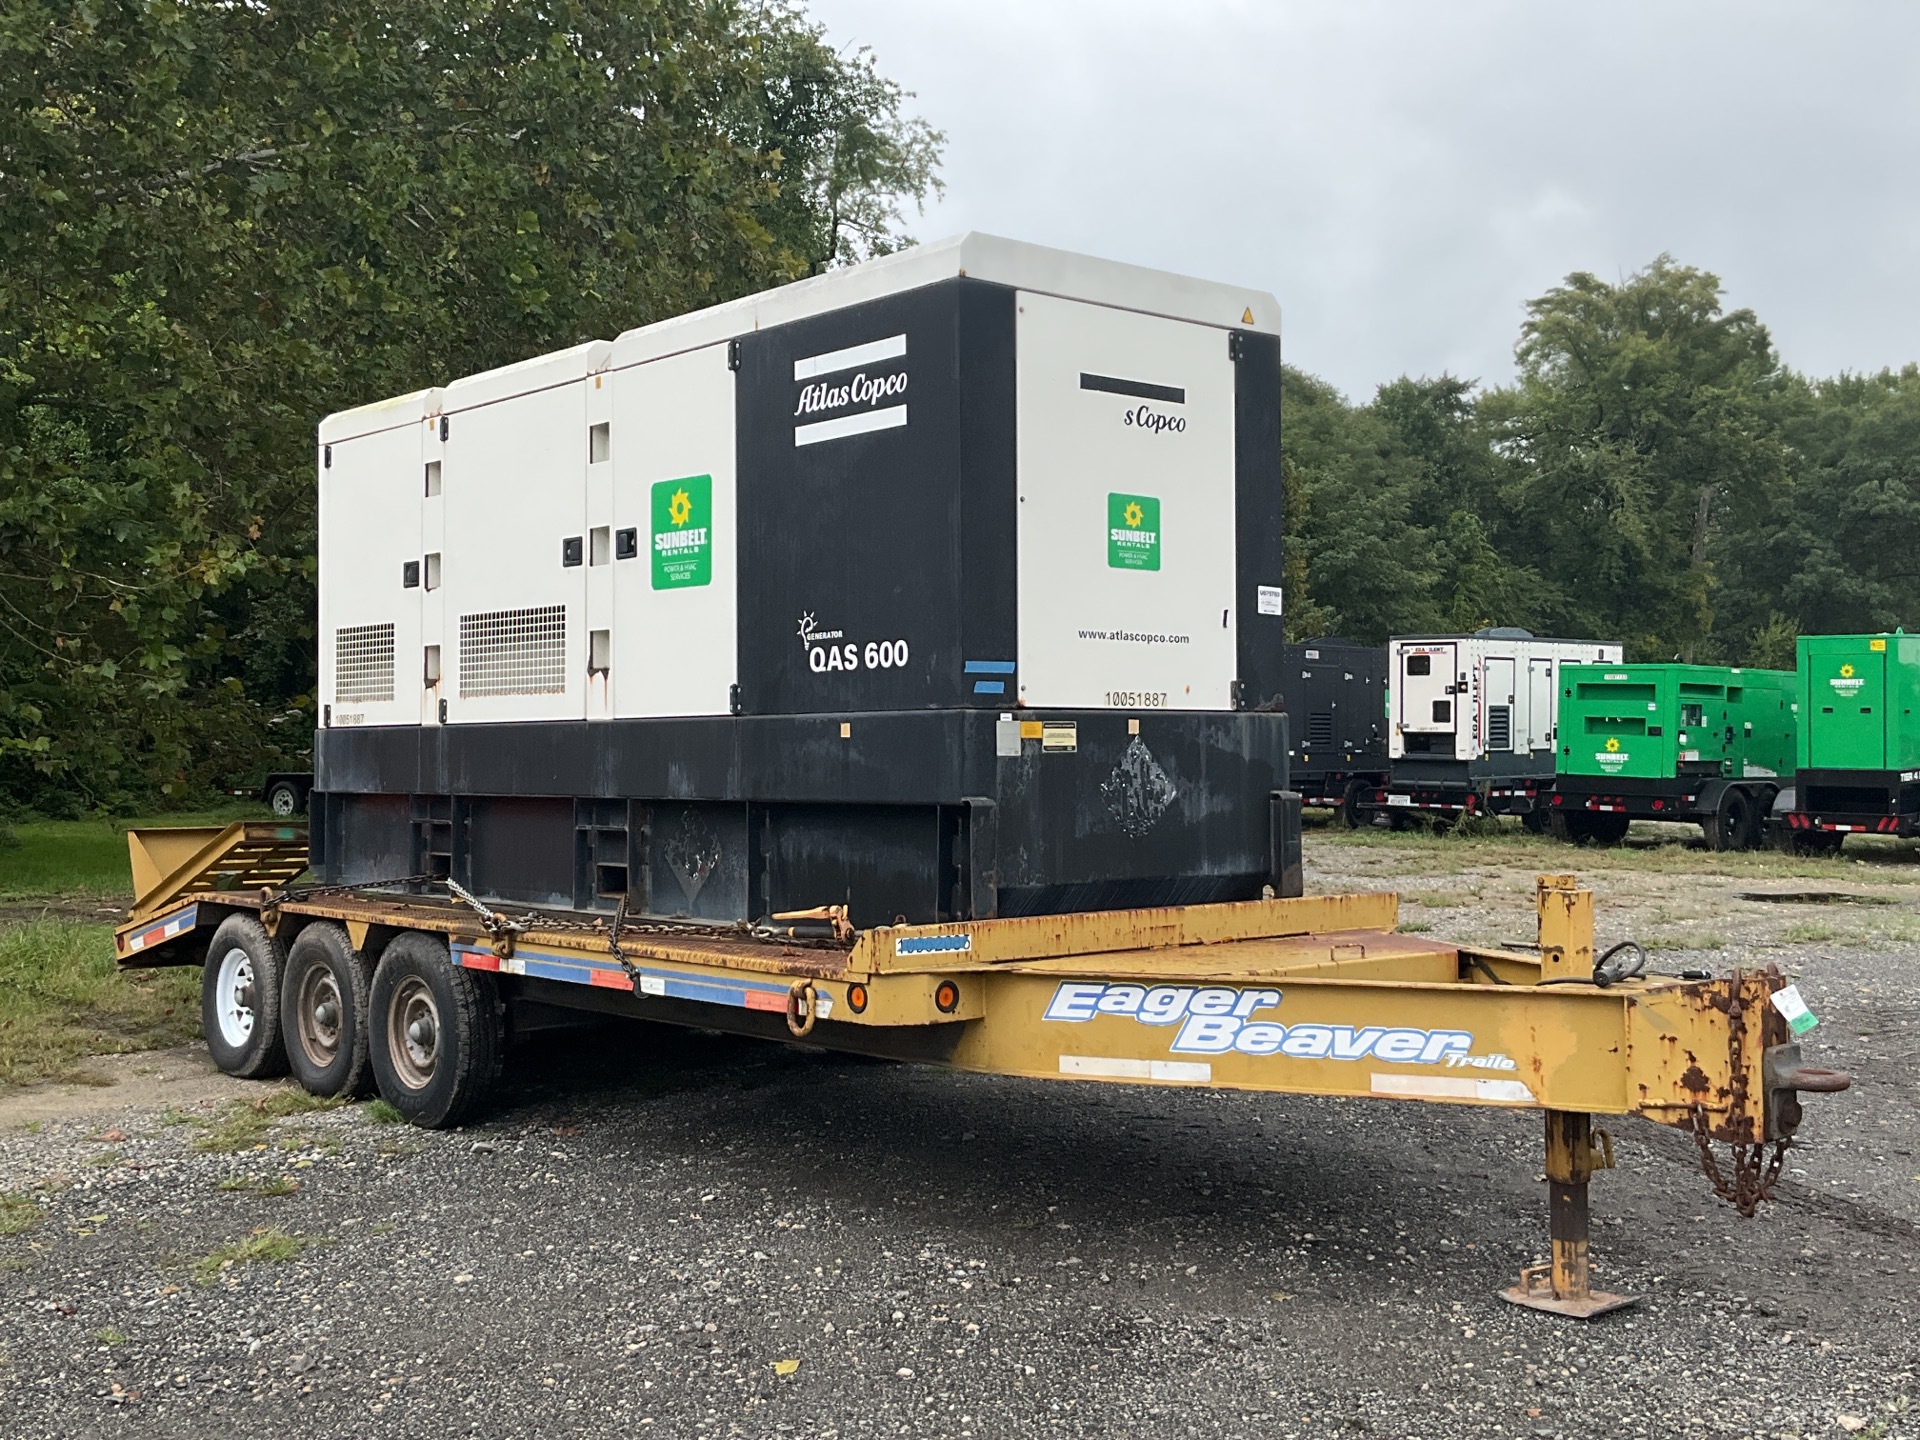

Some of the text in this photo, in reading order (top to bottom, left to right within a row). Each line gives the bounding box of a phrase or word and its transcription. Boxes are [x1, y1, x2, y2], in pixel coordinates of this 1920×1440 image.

[654, 528, 707, 550] SUNBELT
[1110, 528, 1156, 544] SUNBELT
[661, 546, 699, 557] RENTALS
[1117, 541, 1150, 549] RENTALS
[806, 630, 843, 641] GENERATOR
[1078, 630, 1190, 644] www.atlascopco.com
[809, 639, 909, 673] QAS 600
[1105, 691, 1167, 707] 10051887
[335, 713, 365, 726] 10051887
[1595, 752, 1629, 761] SUNBELT
[1900, 772, 1913, 782] TIER
[1043, 980, 1283, 1026] Eager
[1170, 1013, 1474, 1064] Beaver
